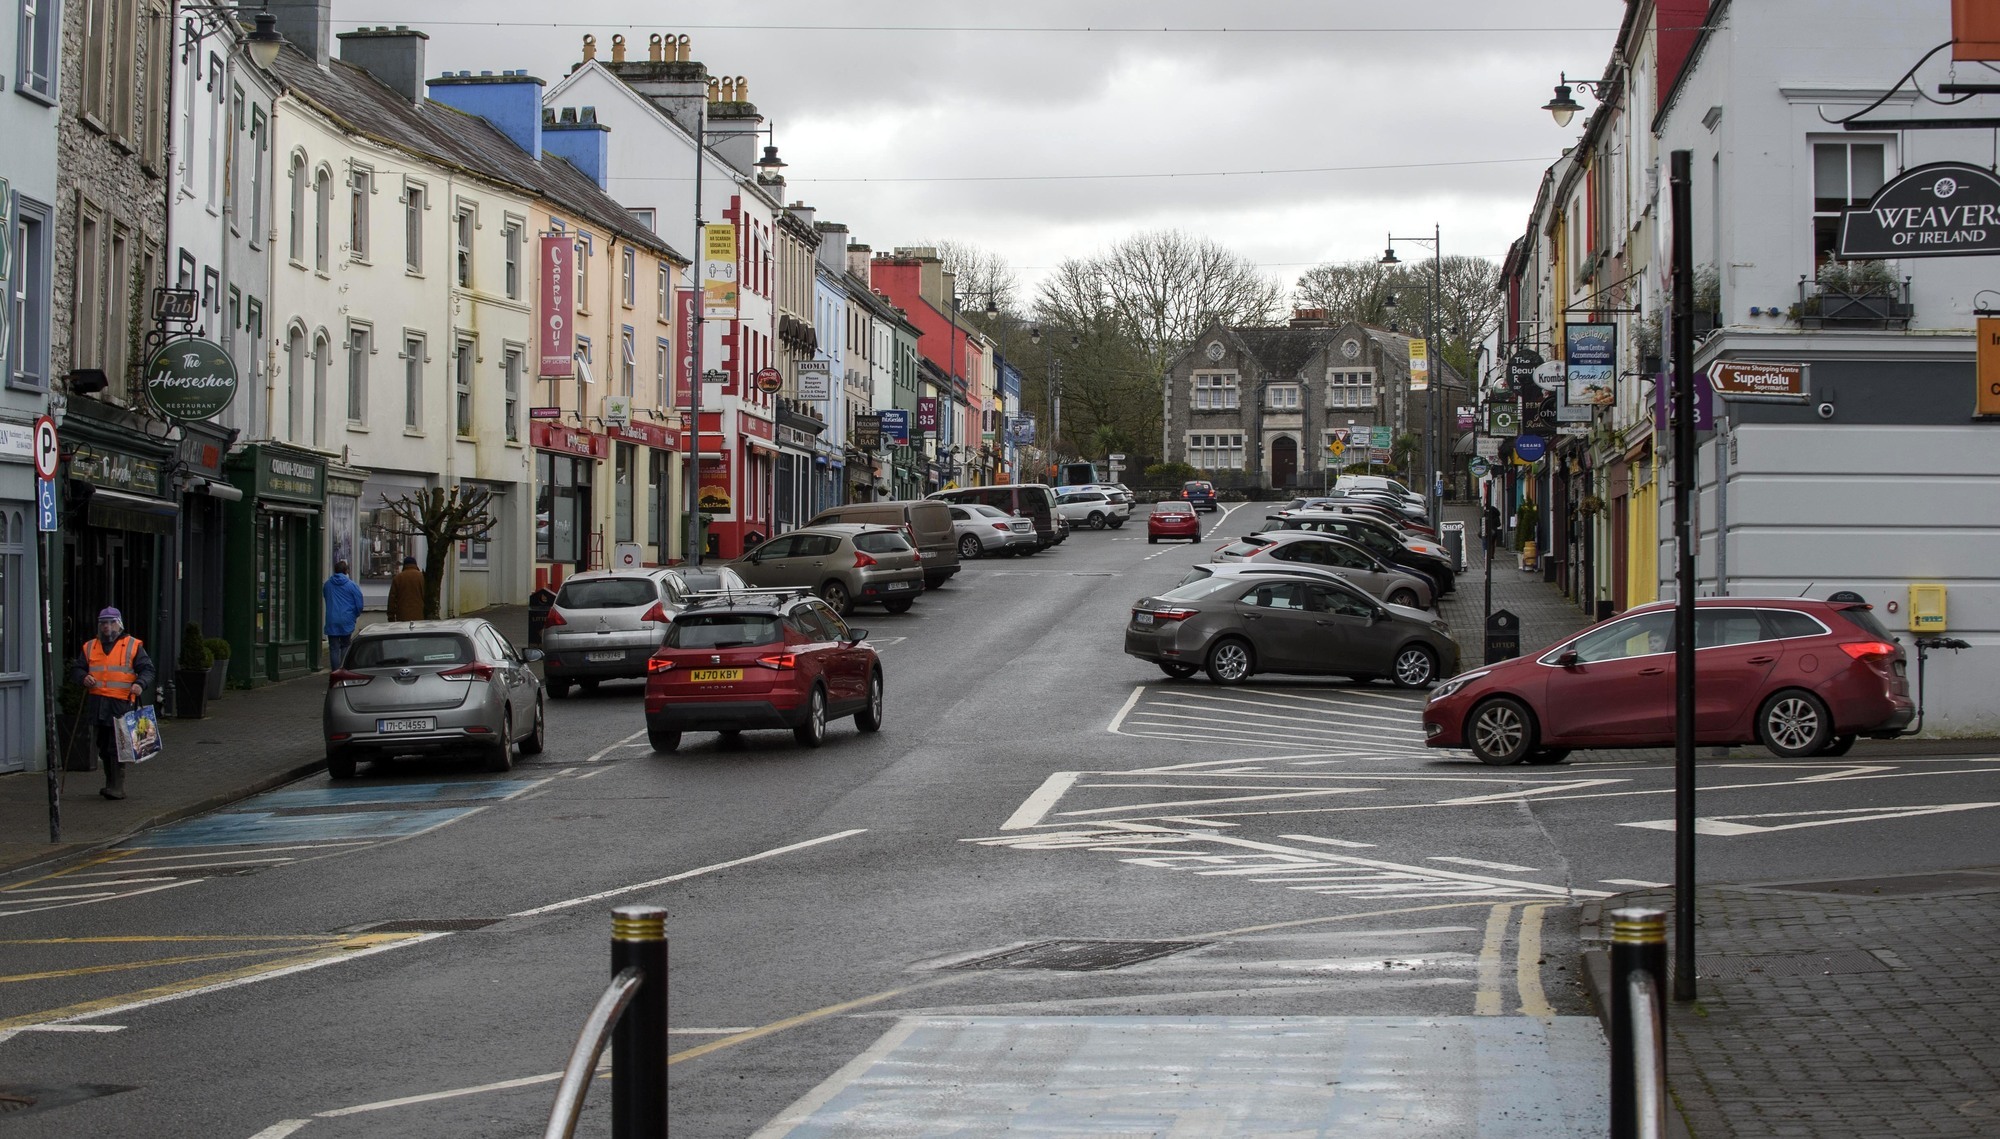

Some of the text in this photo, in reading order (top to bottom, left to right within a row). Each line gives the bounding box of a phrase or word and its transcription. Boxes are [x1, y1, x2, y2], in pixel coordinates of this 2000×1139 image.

[1892, 230, 1987, 245] OF IRELAND
[159, 294, 192, 314] Pub
[182, 353, 202, 369] The
[1569, 370, 1612, 380] Ocean 10
[1752, 365, 1779, 373] Shopping
[148, 370, 235, 389] Horseshoe
[1734, 372, 1789, 386] SuperValu
[919, 415, 934, 425] 35
[45, 512, 52, 529] P
[720, 670, 738, 679] KBY
[386, 720, 427, 731] 171-C-14553
